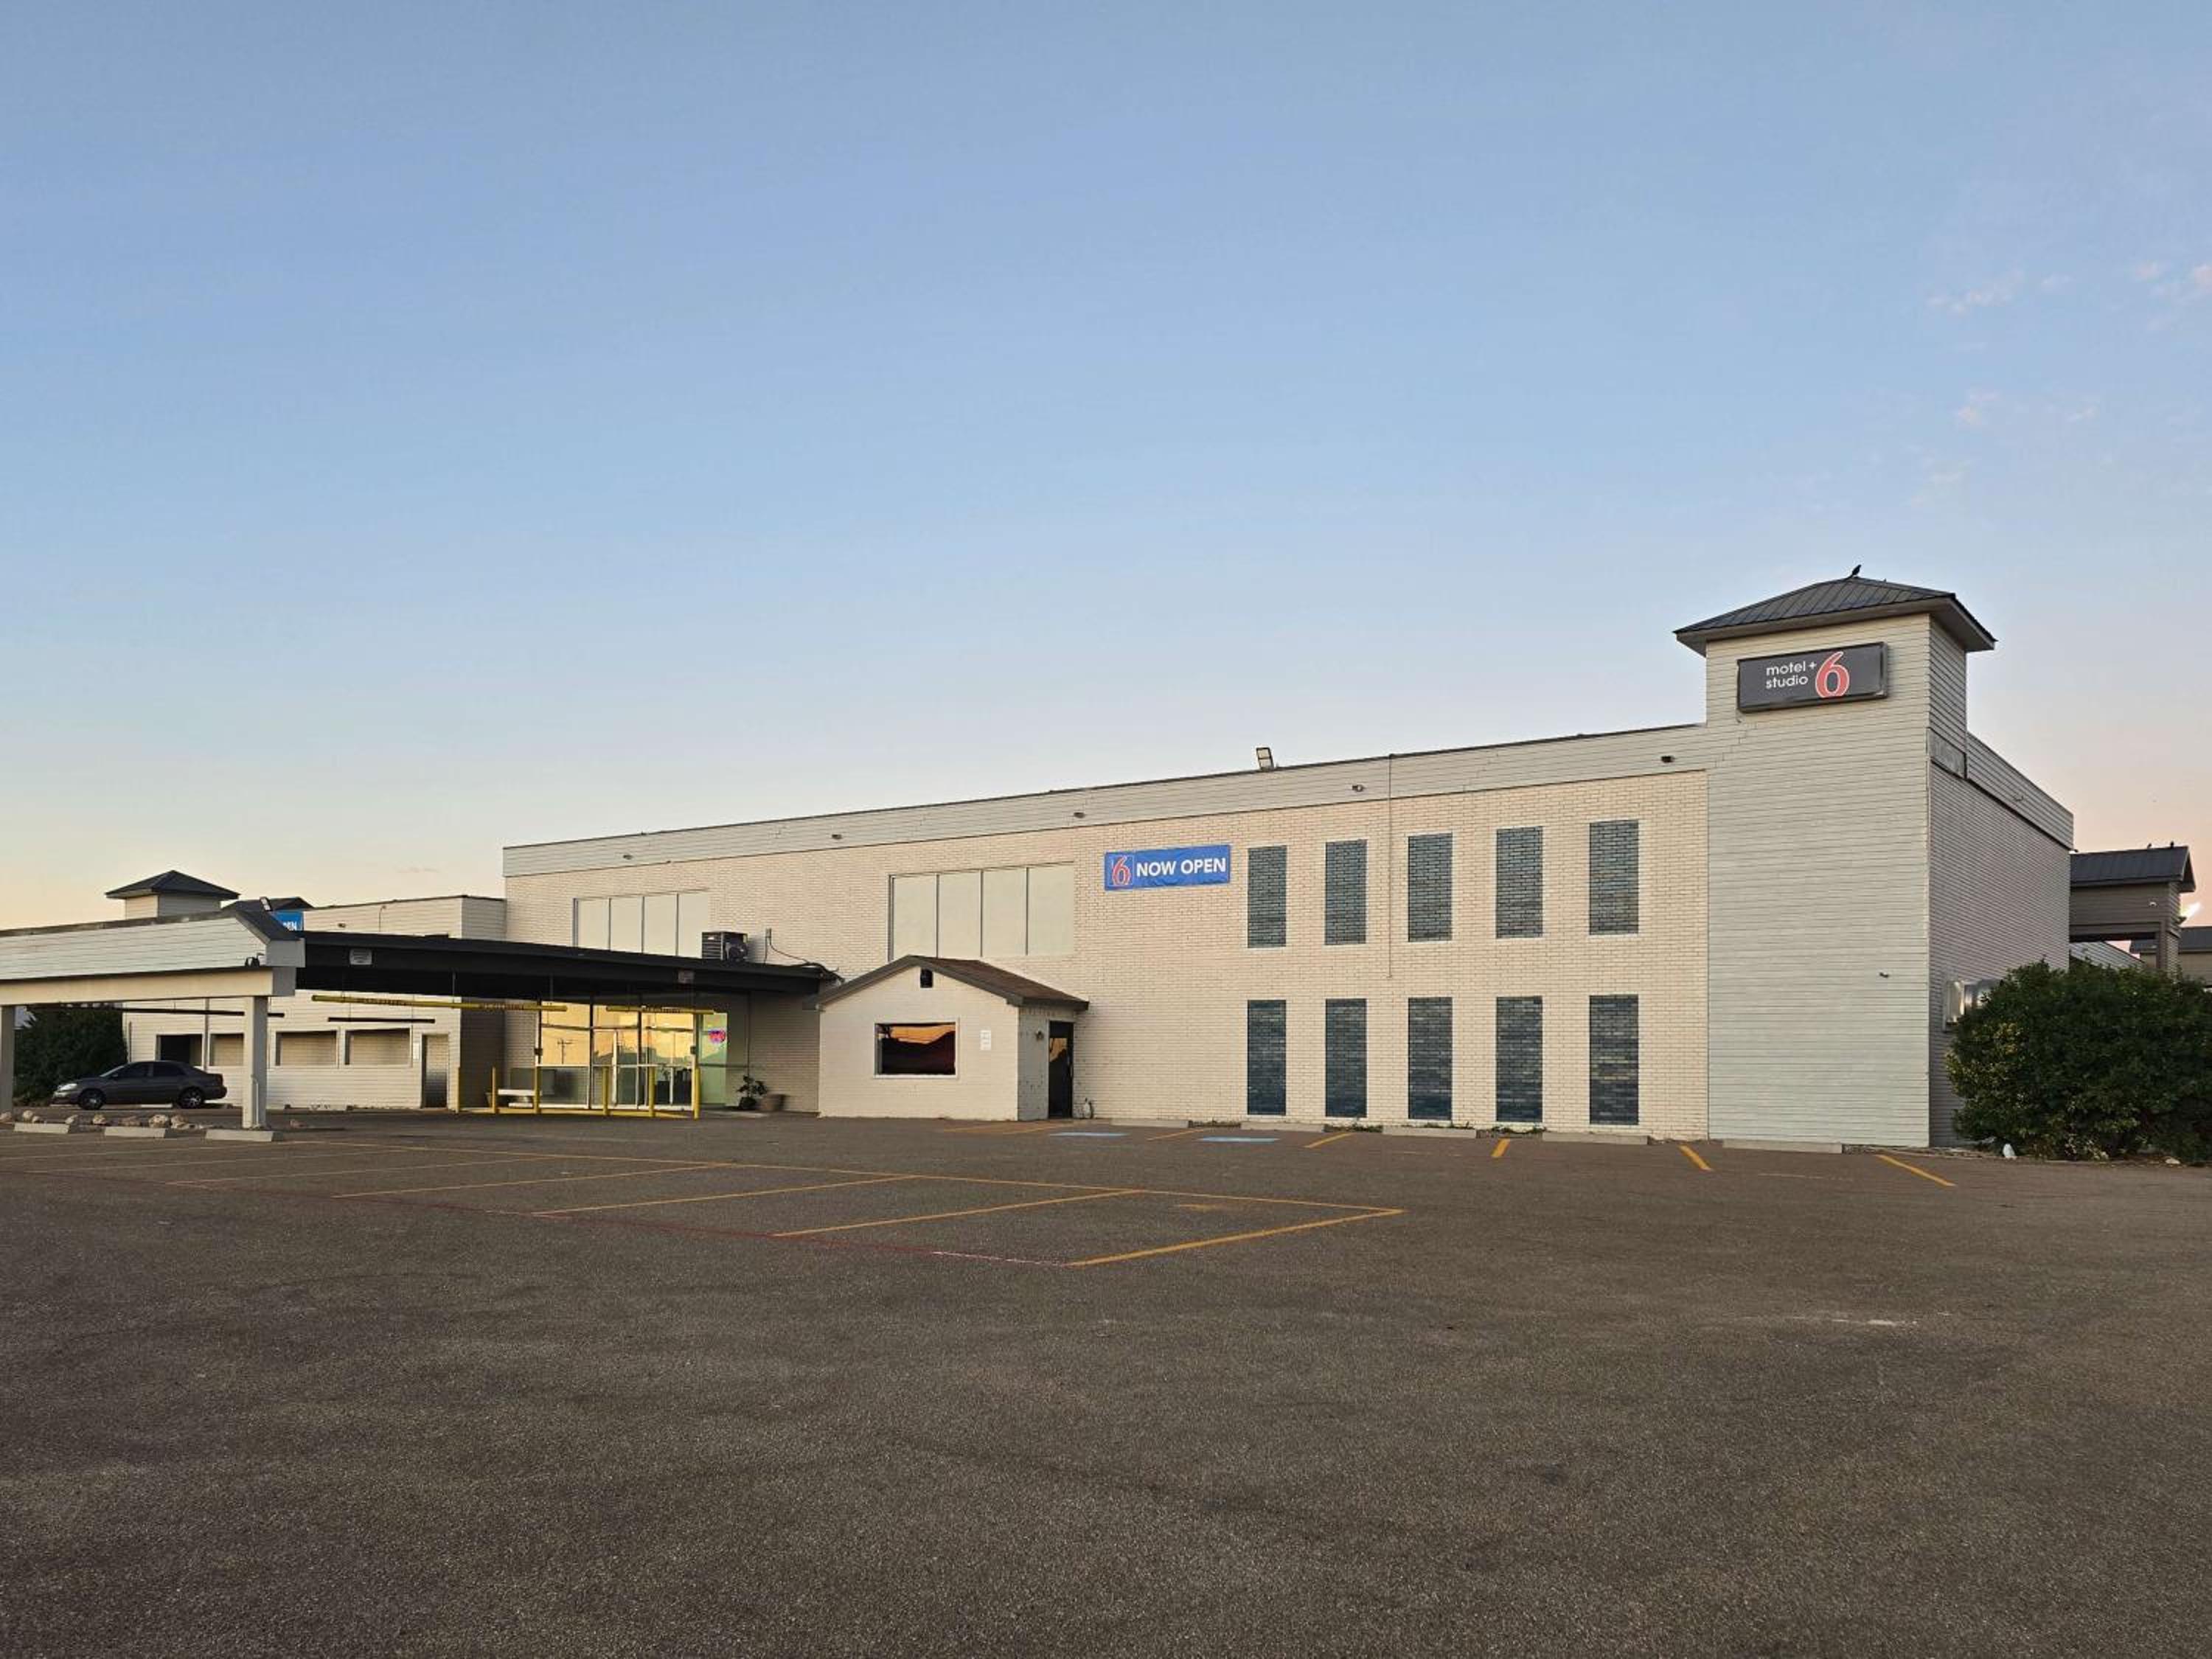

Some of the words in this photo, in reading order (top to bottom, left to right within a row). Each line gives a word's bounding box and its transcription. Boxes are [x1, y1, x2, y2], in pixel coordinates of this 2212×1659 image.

[1765, 675, 1809, 689] studio
[1815, 651, 1850, 698] 6
[1136, 860, 1176, 877] NOW
[1180, 858, 1226, 874] OPEN
